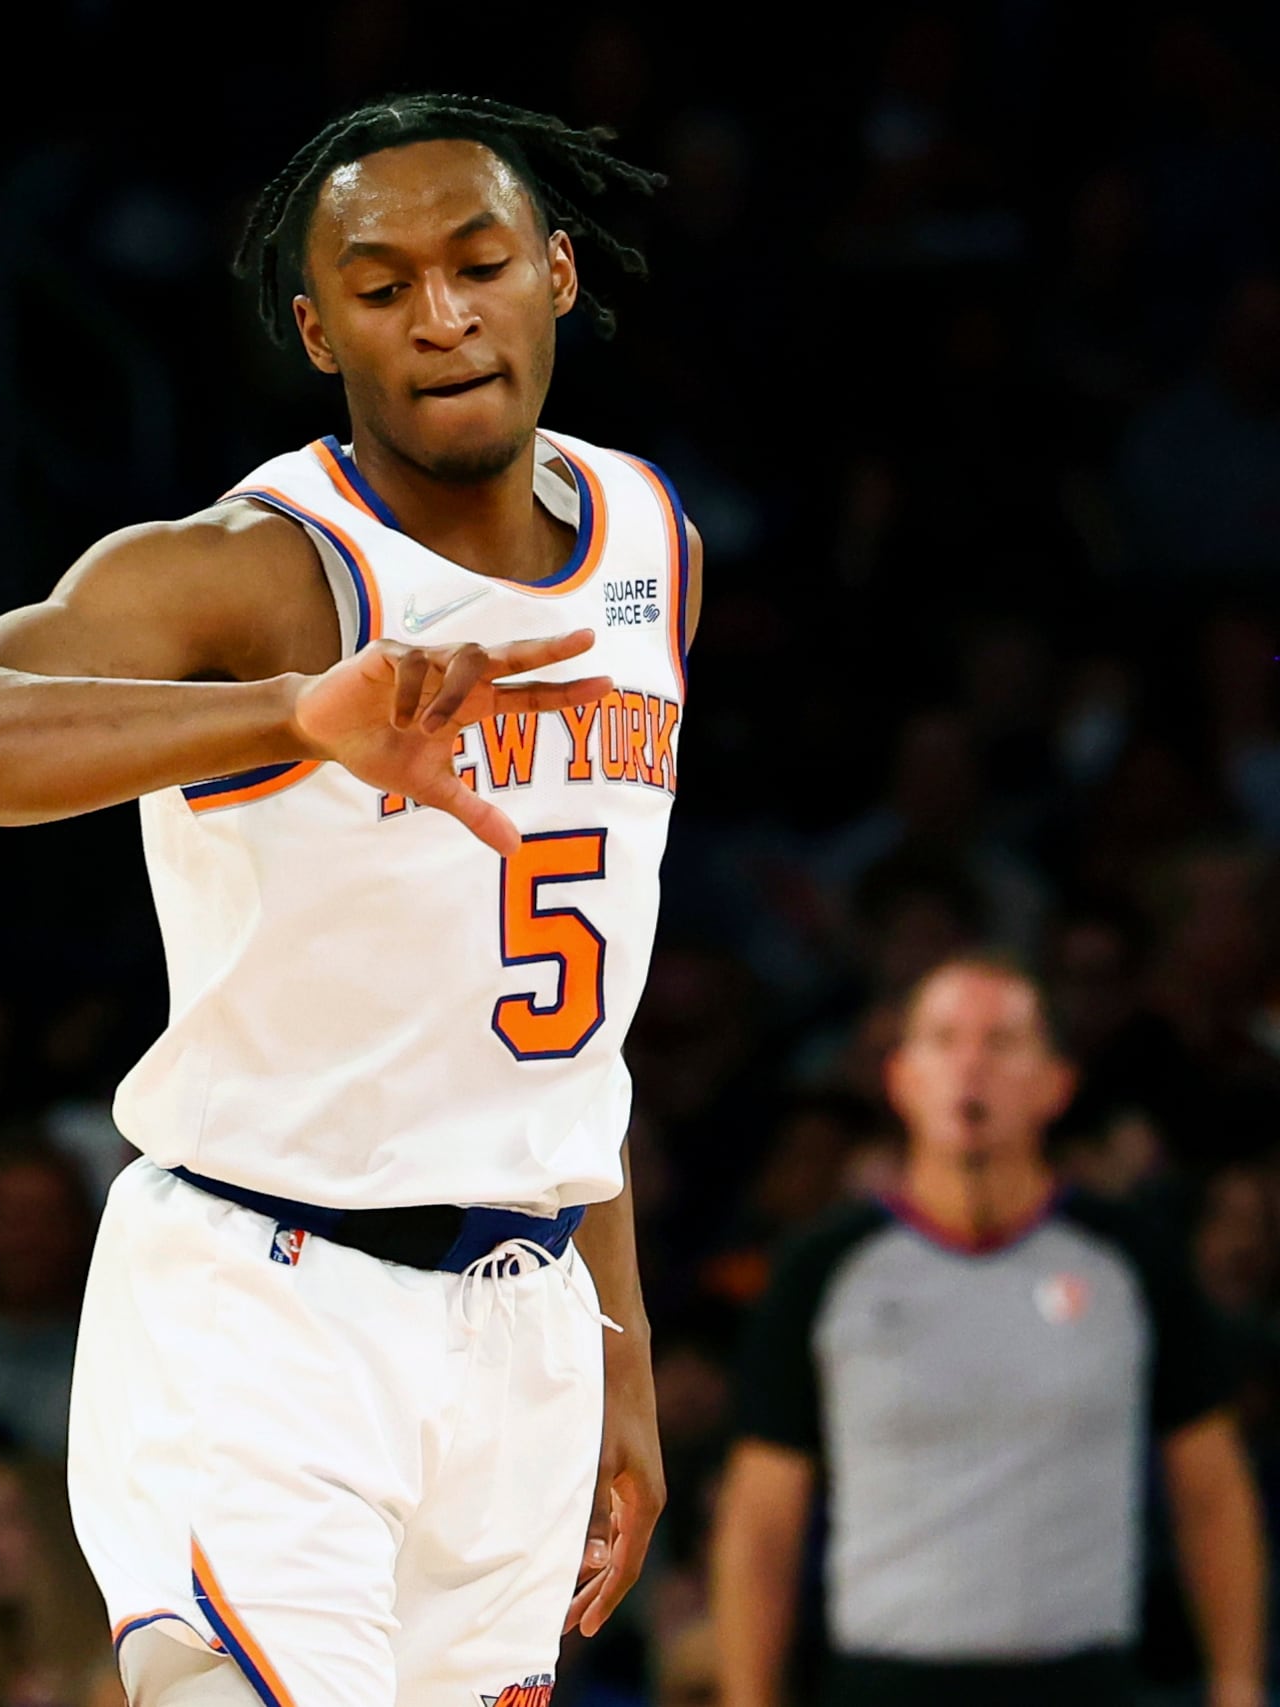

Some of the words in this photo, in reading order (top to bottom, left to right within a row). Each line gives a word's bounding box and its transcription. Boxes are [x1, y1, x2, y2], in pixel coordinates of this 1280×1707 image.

[605, 604, 641, 627] SPACE
[558, 687, 679, 797] YORK
[491, 827, 607, 1061] 5
